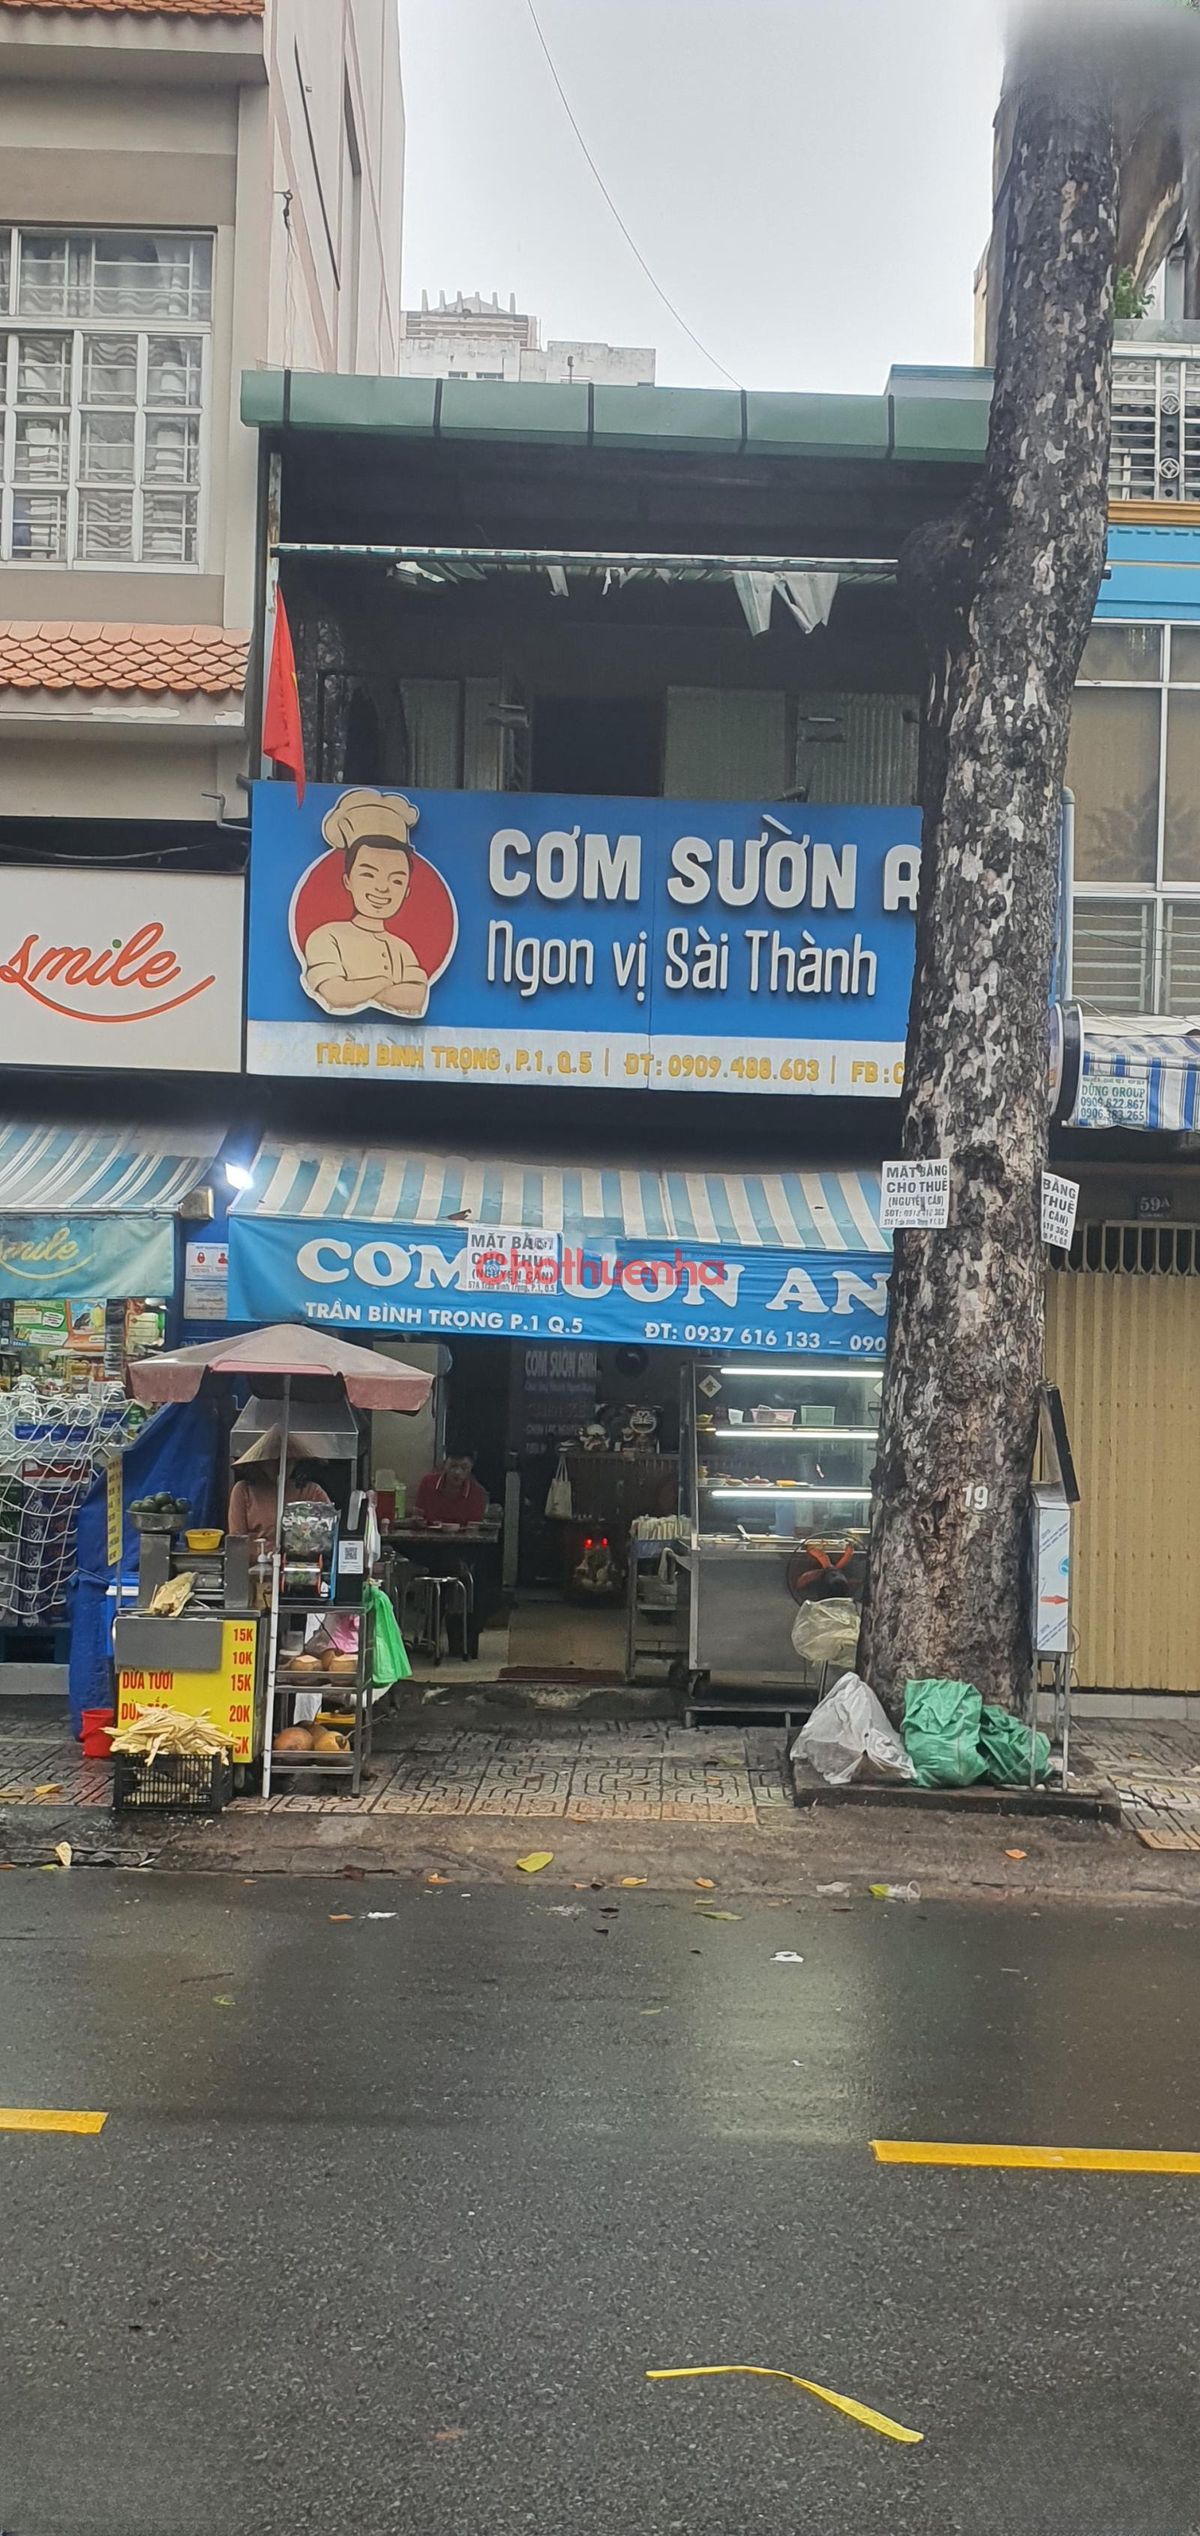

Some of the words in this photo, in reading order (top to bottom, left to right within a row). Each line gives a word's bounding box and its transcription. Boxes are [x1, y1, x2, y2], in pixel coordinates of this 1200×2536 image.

[489, 824, 642, 900] CƠM
[667, 814, 858, 910] SƯỜN
[0, 921, 182, 989] smile
[487, 920, 595, 997] Ngon
[612, 930, 648, 1003] vị
[665, 925, 730, 991] Sài
[744, 928, 878, 997] Thành
[316, 1031, 370, 1066] TRẦN
[376, 1035, 424, 1068] BÌNH
[557, 1051, 593, 1074] Q.5
[1112, 1086, 1146, 1099] GROUP
[886, 1181, 917, 1194] CHO
[471, 1232, 507, 1251] MẶT
[305, 1298, 361, 1321] TRẦN
[368, 1302, 422, 1325] BÌNH
[428, 1309, 504, 1331] TRỌNG
[510, 1314, 539, 1331] P.1
[547, 1316, 584, 1335] Q.5
[645, 1321, 678, 1340] ĐT:
[684, 1324, 735, 1344] 0937
[740, 1328, 777, 1346] 616
[785, 1331, 821, 1348] 133
[850, 1335, 887, 1352] 090
[962, 1482, 989, 1511] 19
[233, 1628, 254, 1642] 15K
[232, 1652, 253, 1665] 10K
[231, 1674, 252, 1692] 15K
[229, 1705, 250, 1723] 20K
